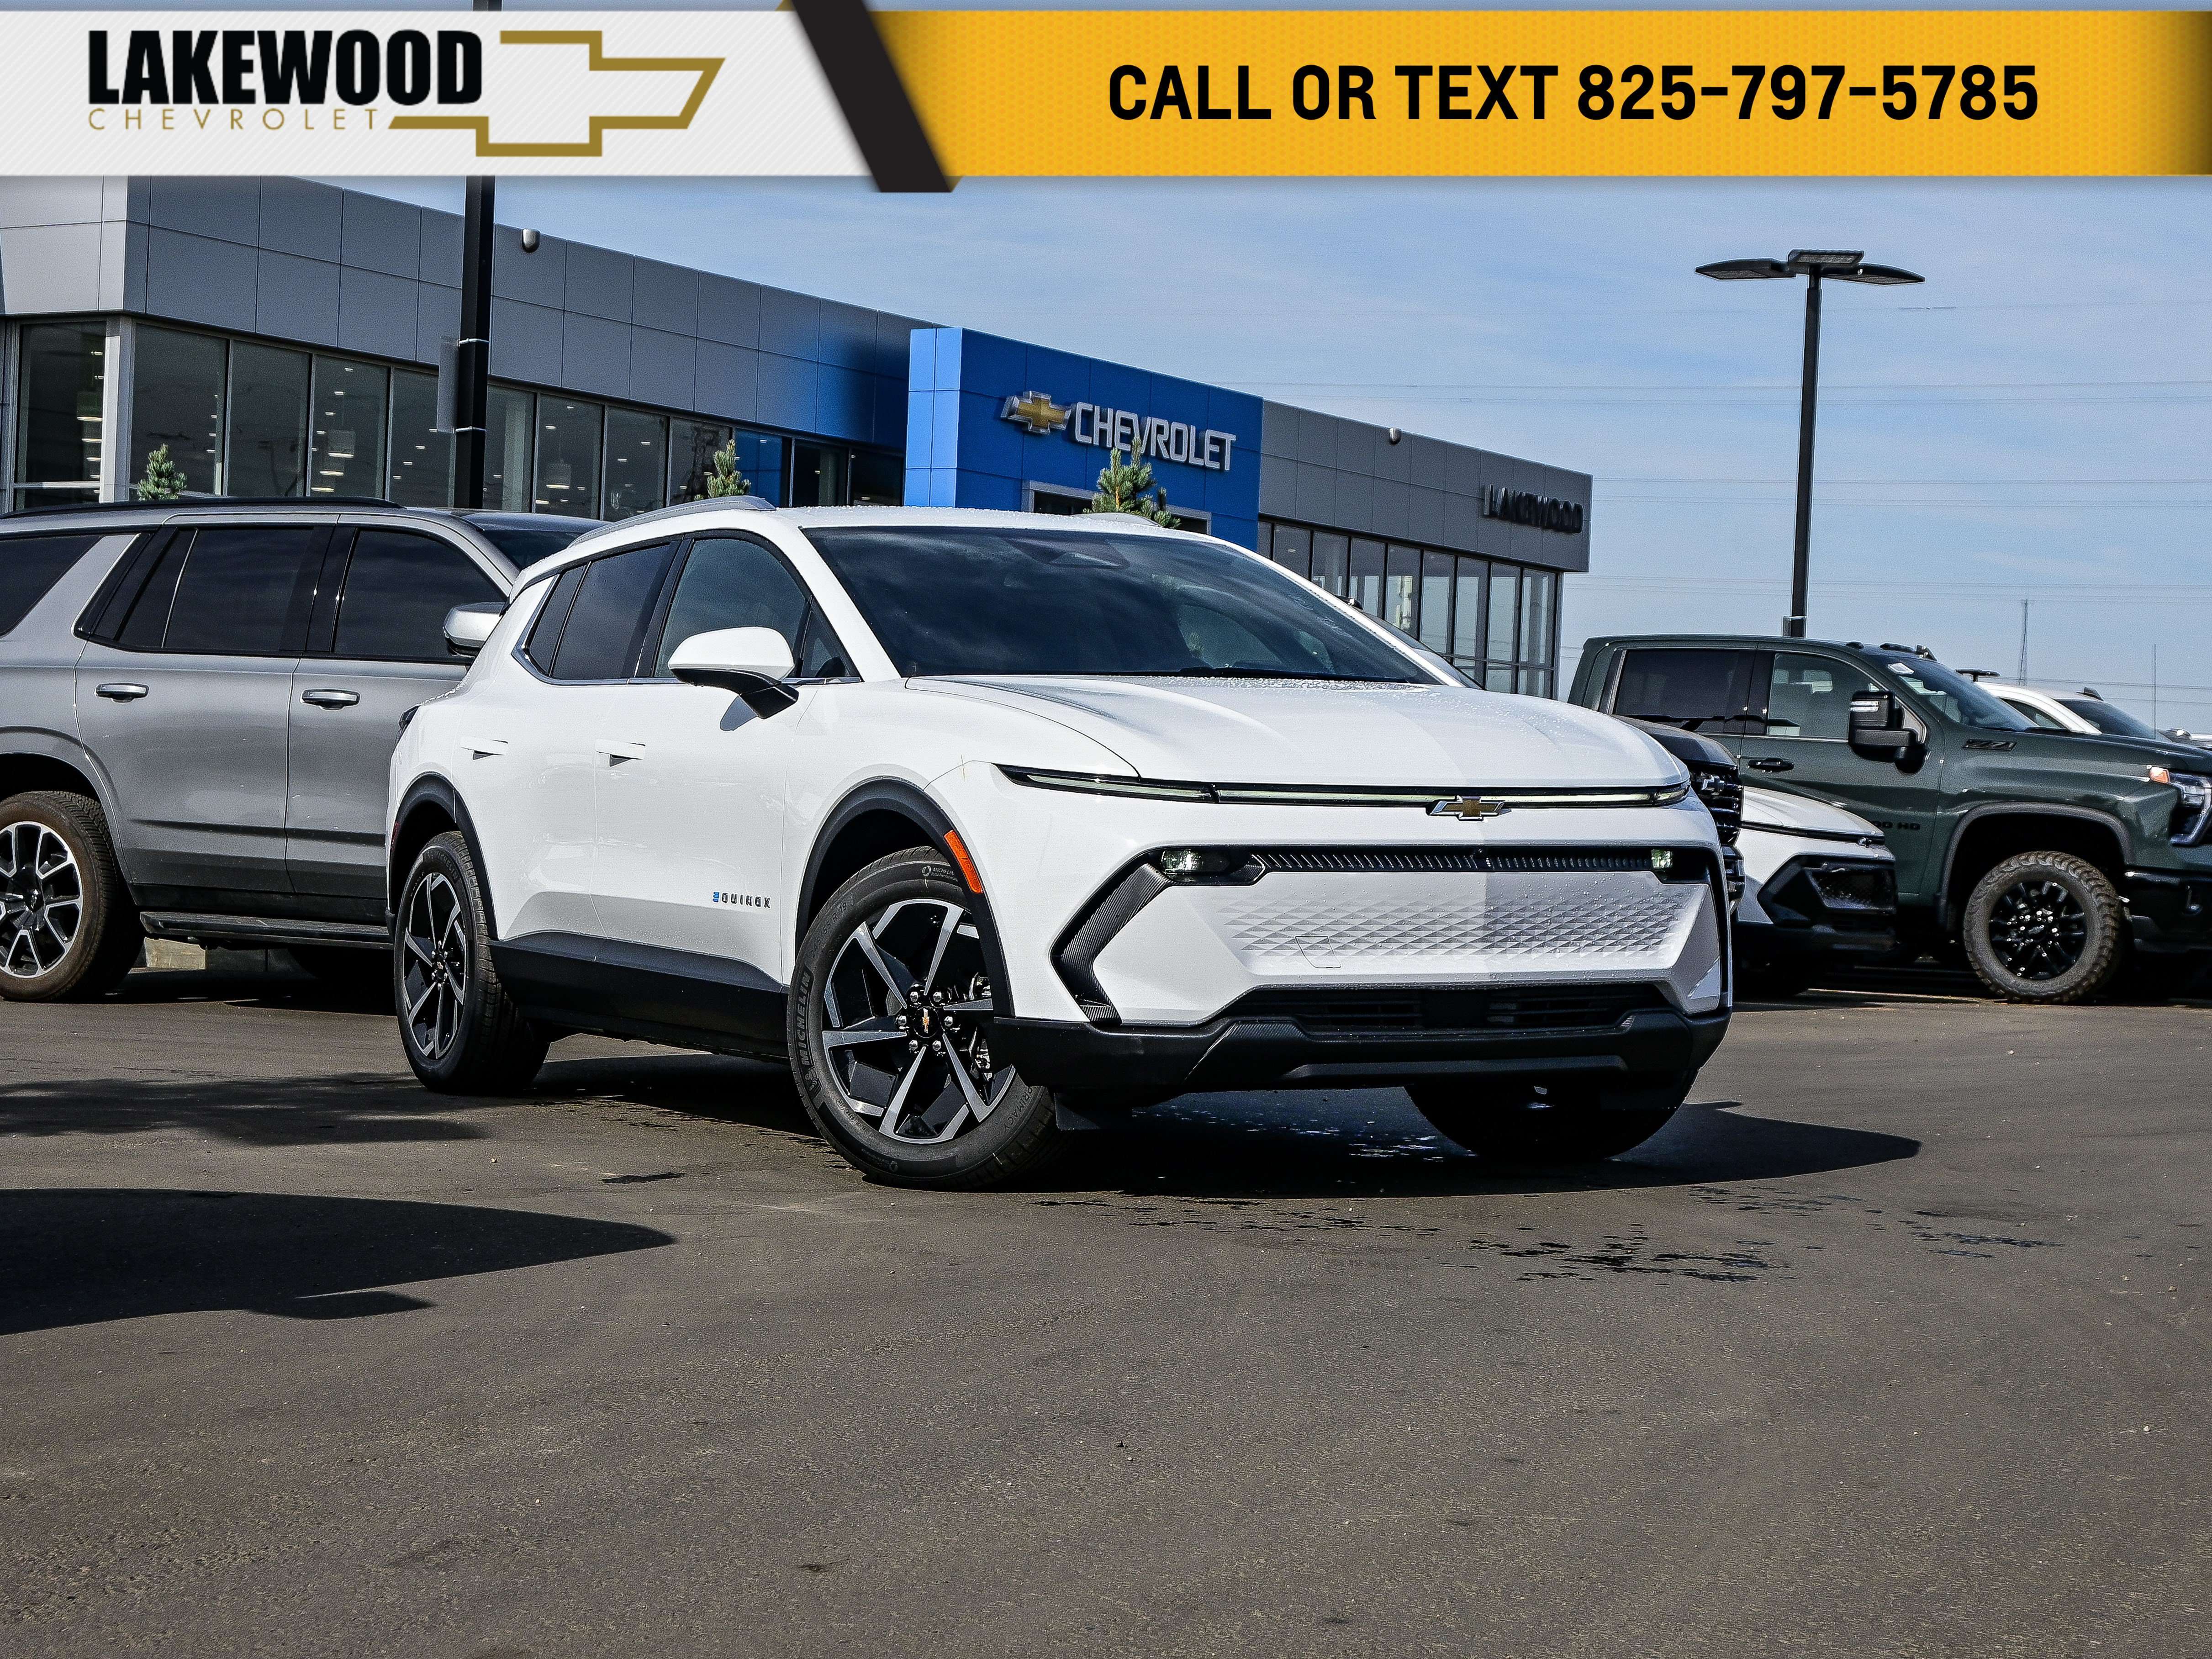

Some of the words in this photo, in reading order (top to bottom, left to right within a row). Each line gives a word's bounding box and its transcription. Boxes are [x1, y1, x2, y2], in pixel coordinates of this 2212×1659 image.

[1074, 401, 1236, 471] CHEVROLET
[712, 891, 771, 909] EQUINOX
[797, 971, 811, 1066] MICHELIN
